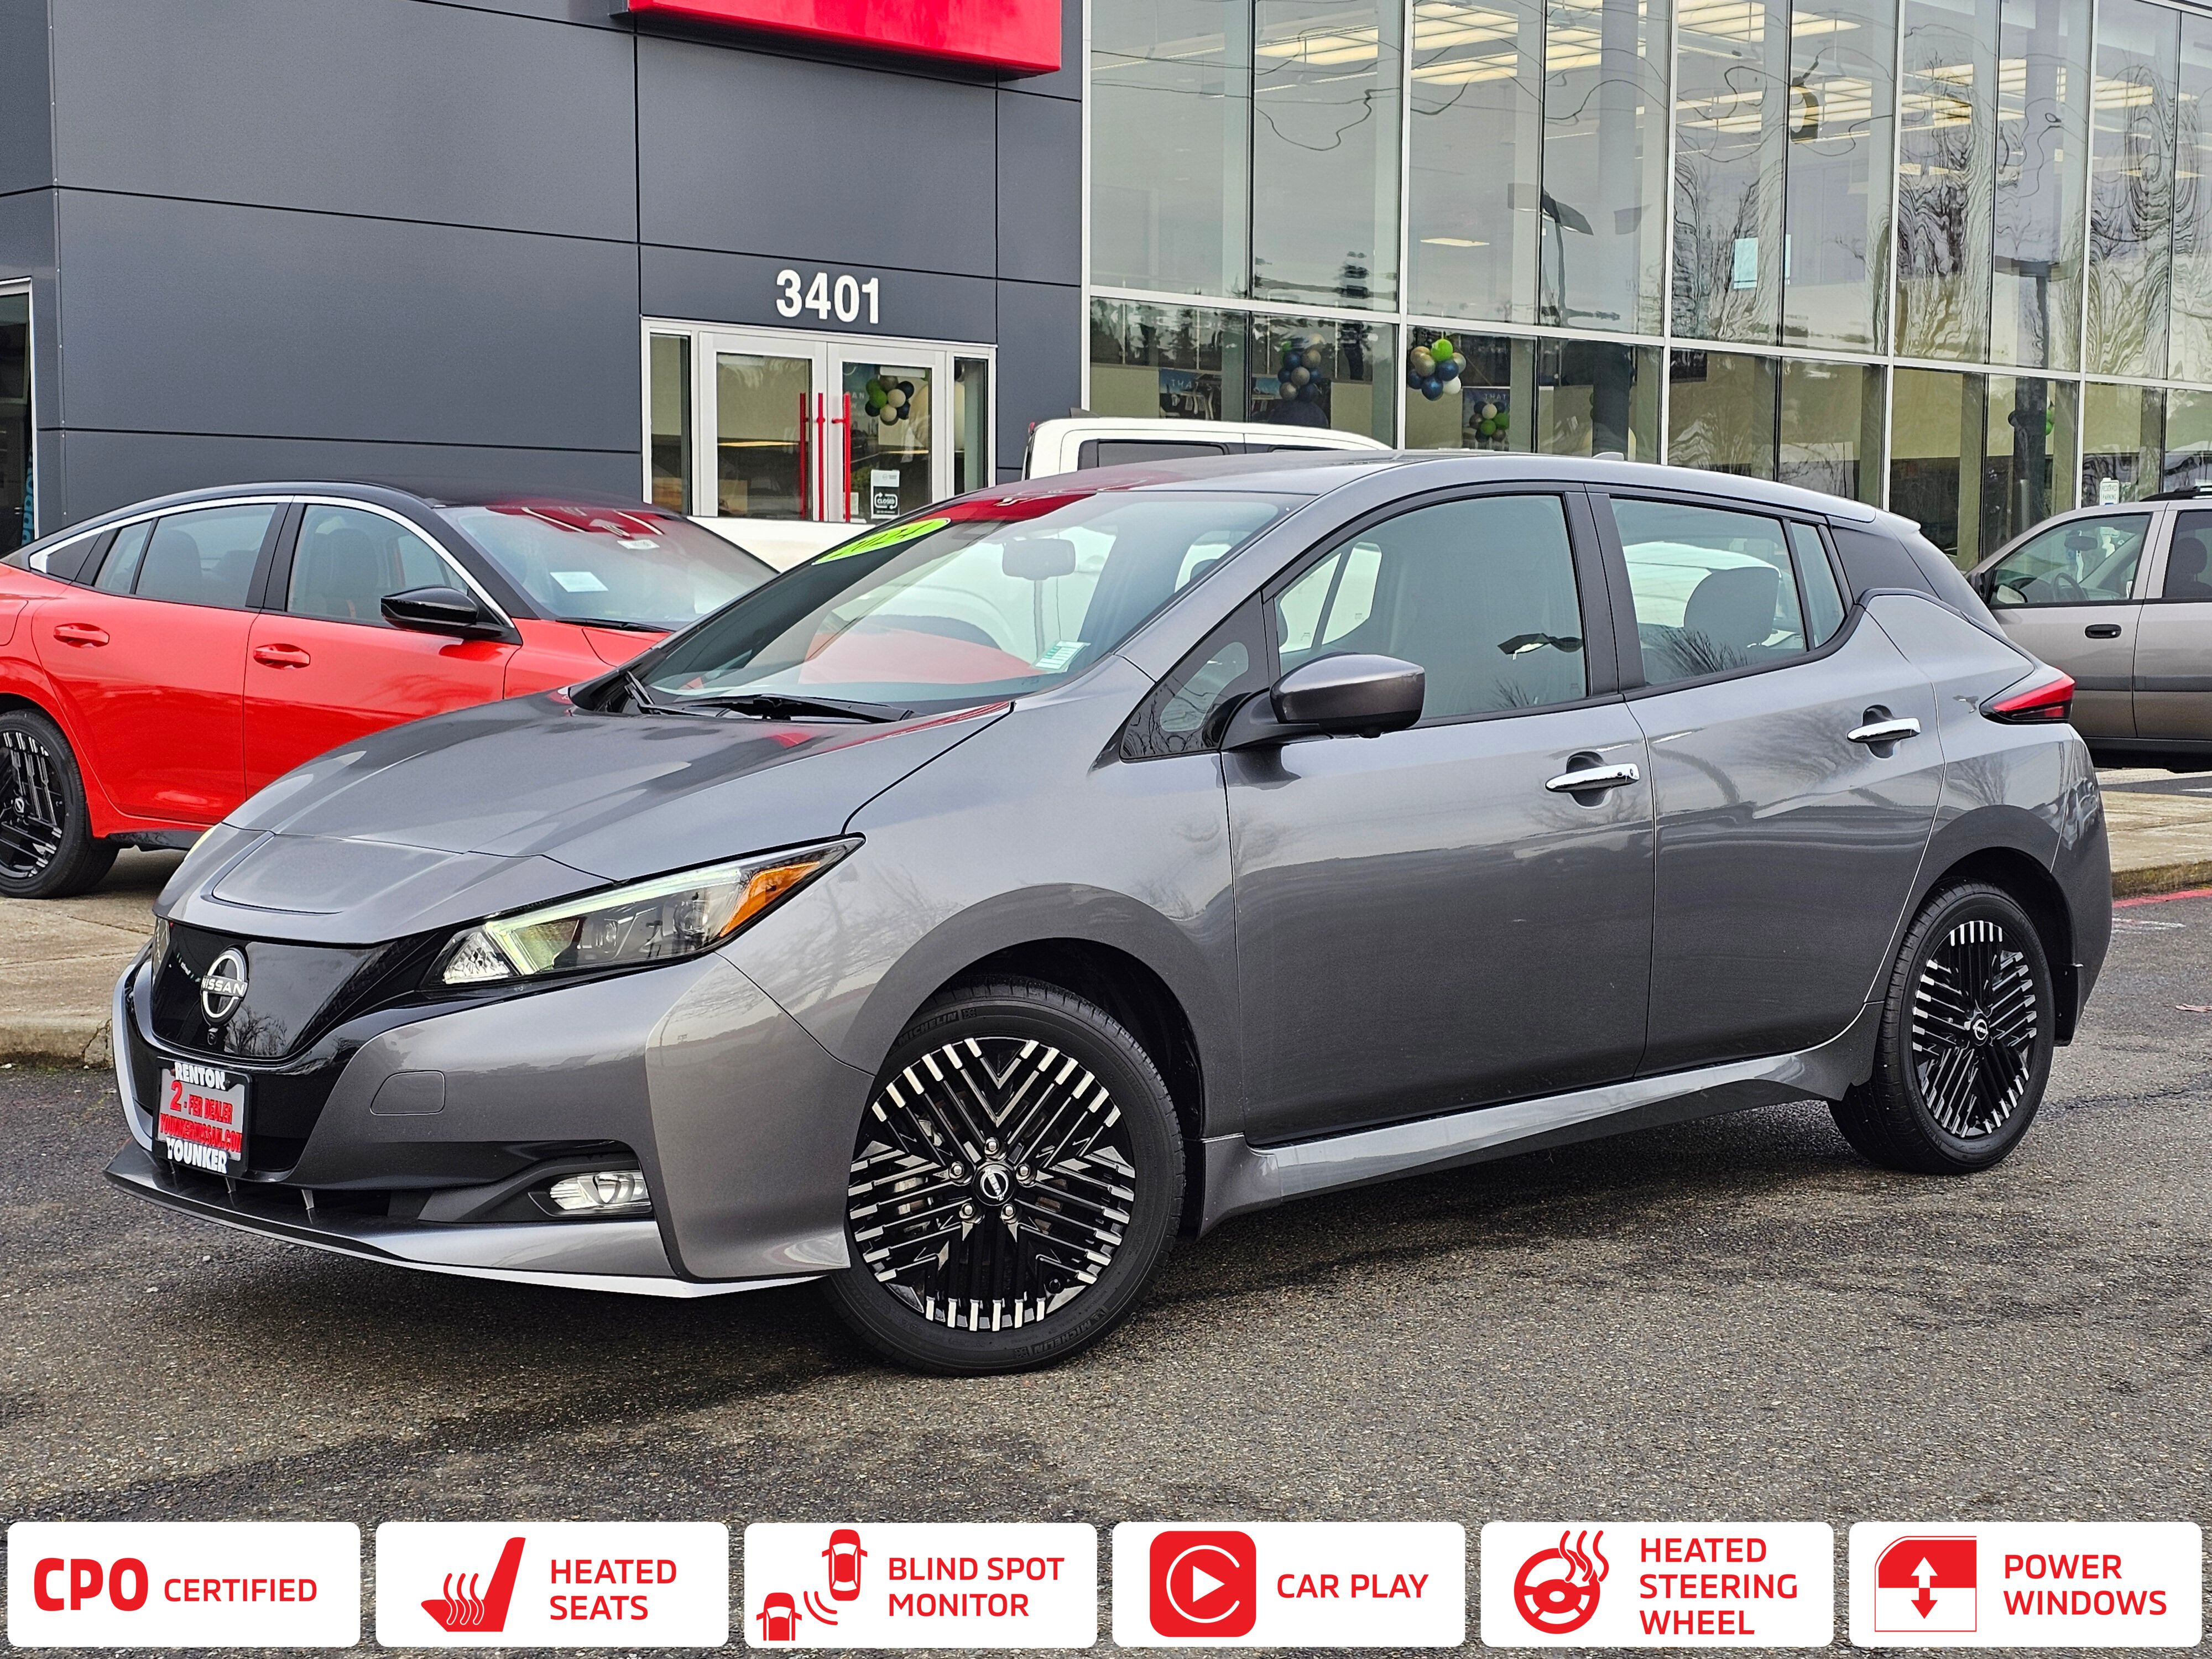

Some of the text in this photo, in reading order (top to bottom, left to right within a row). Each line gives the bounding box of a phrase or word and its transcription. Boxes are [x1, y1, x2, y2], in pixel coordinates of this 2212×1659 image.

[776, 269, 879, 324] 3401
[201, 977, 245, 996] NISSAN
[898, 1013, 958, 1045] MICHELIN
[174, 1062, 226, 1091] RENTON
[204, 1098, 233, 1125] DEALER
[166, 1136, 227, 1174] YOUNKER
